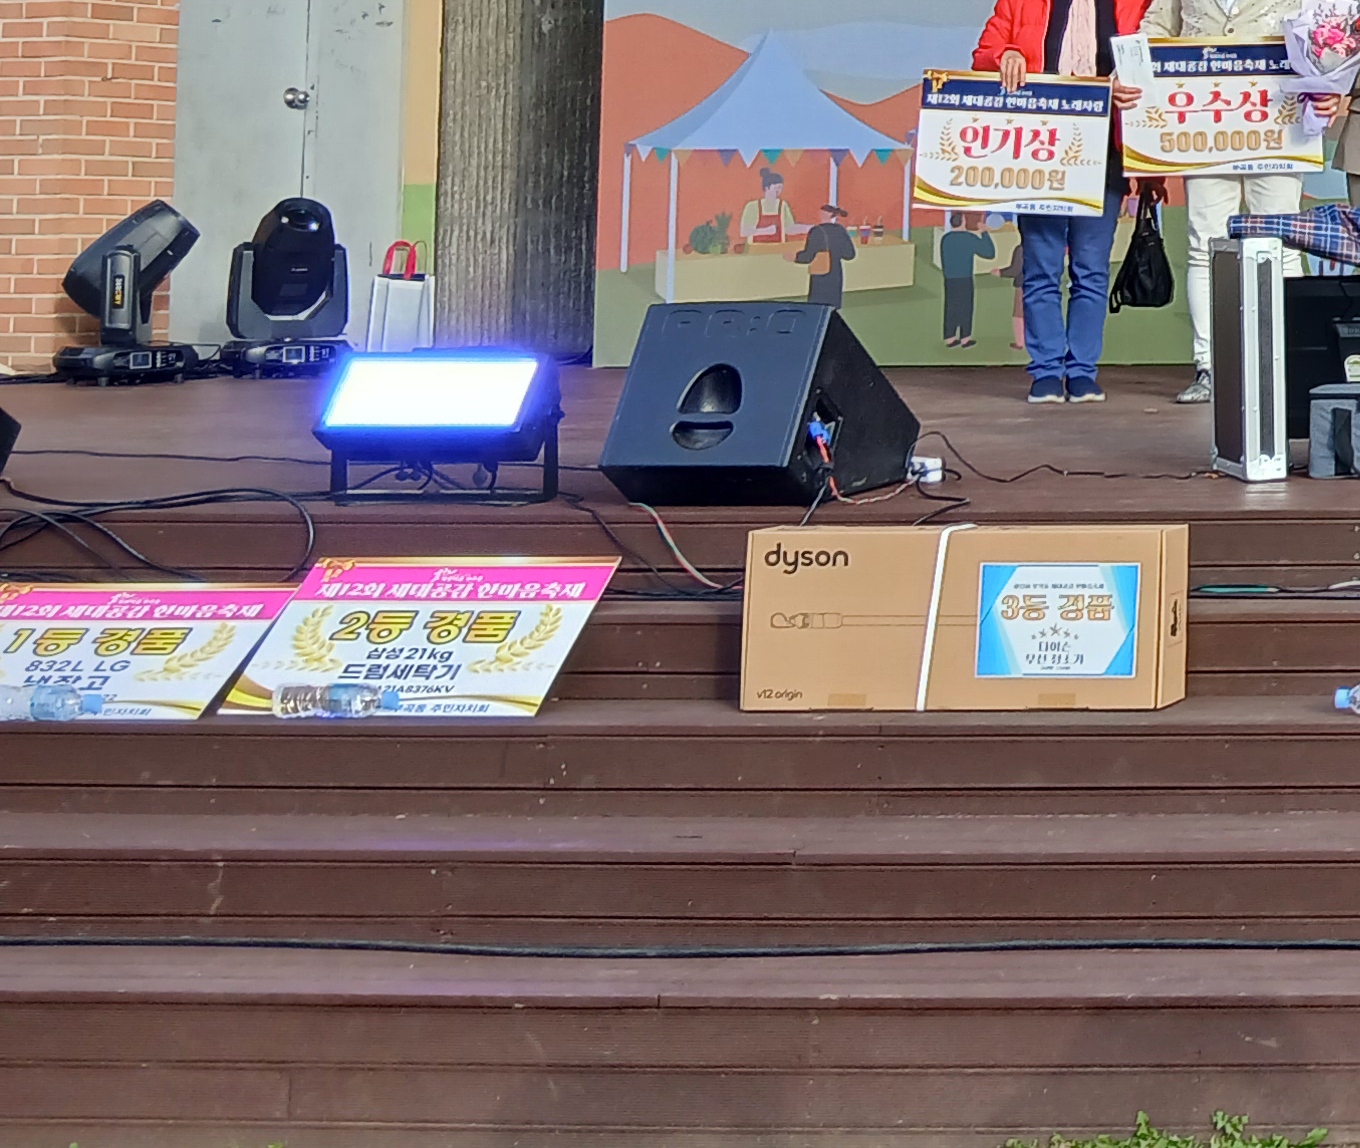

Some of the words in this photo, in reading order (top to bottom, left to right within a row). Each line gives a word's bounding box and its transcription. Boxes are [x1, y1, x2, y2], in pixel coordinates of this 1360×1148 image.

[1164, 89, 1273, 124] 우수상
[959, 125, 1061, 162] 인기상
[1159, 128, 1283, 153] 500,000원
[949, 165, 1067, 191] 200,000원
[764, 543, 849, 574] dyson
[316, 583, 385, 599] 제12회
[386, 583, 475, 599] 세대공감
[477, 582, 587, 599] 한마음축제
[58, 604, 150, 619] 세대공감
[152, 603, 265, 619] 한마음축제
[1000, 594, 1050, 621] 3등
[1057, 594, 1115, 621] 경품
[329, 610, 420, 644] 2등
[423, 610, 521, 644] 경품
[4, 627, 90, 657] 1등
[92, 627, 193, 657] 경품
[25, 660, 84, 672] 832L
[93, 660, 131, 672] LG
[366, 647, 404, 660] 삼성
[404, 647, 454, 663] 21kg
[338, 663, 462, 681] 드럼세탁기
[430, 704, 491, 713] 주민자치회
